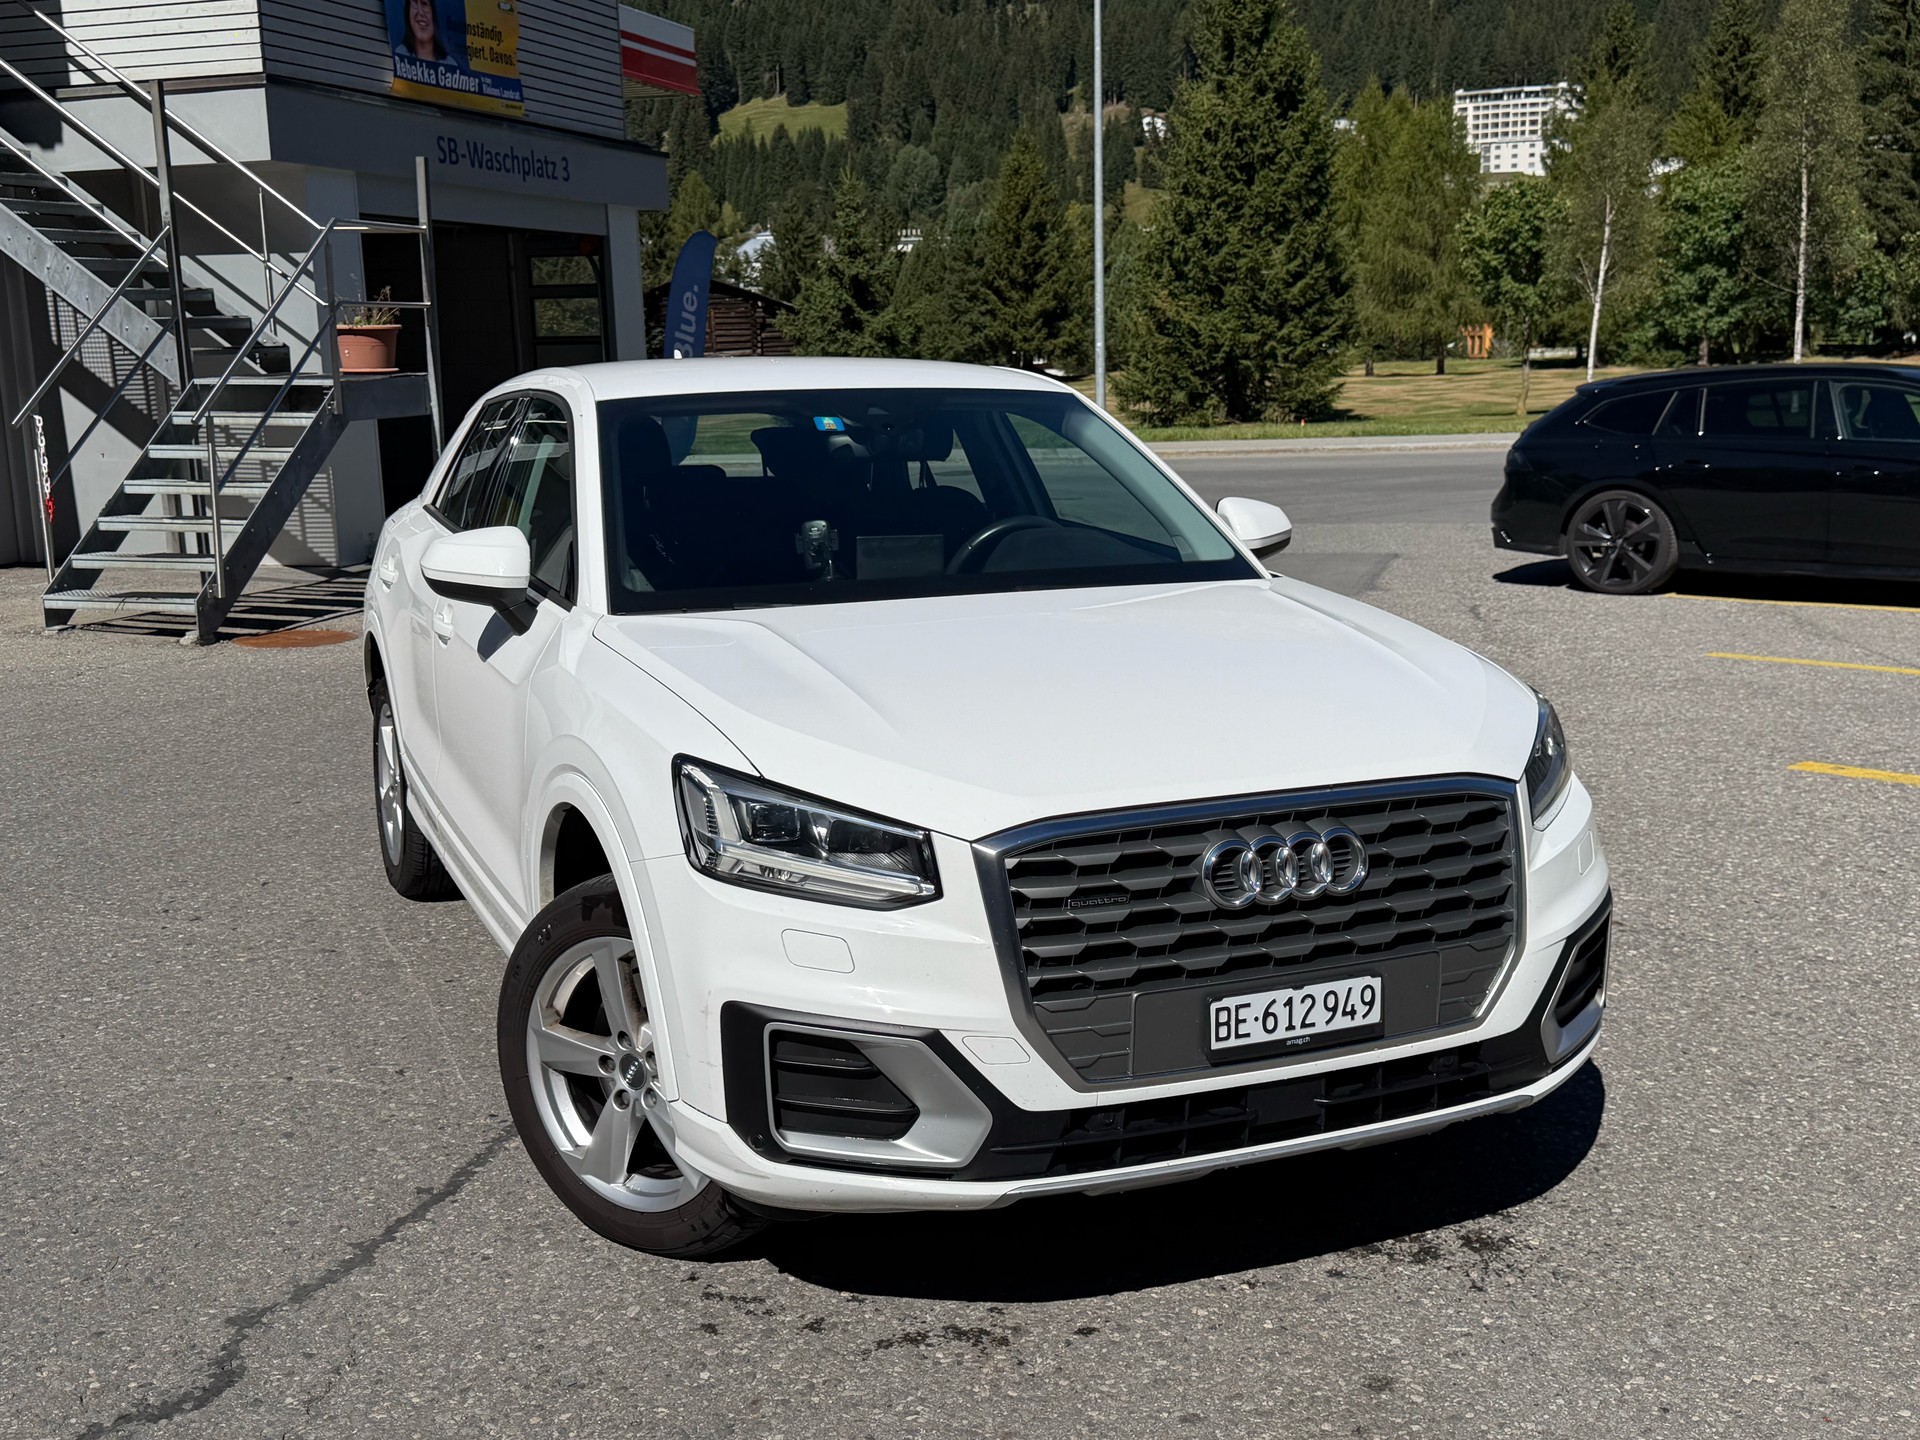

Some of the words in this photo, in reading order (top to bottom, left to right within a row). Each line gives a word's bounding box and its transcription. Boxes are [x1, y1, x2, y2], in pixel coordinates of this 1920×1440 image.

[489, 46, 515, 67] Davos.
[394, 55, 437, 85] Rebekka
[437, 66, 479, 93] Gadmer
[436, 135, 558, 182] SB-Waschplatz
[561, 156, 571, 182] 3
[1071, 896, 1127, 908] quattro
[1286, 1036, 1311, 1046] amag.ch
